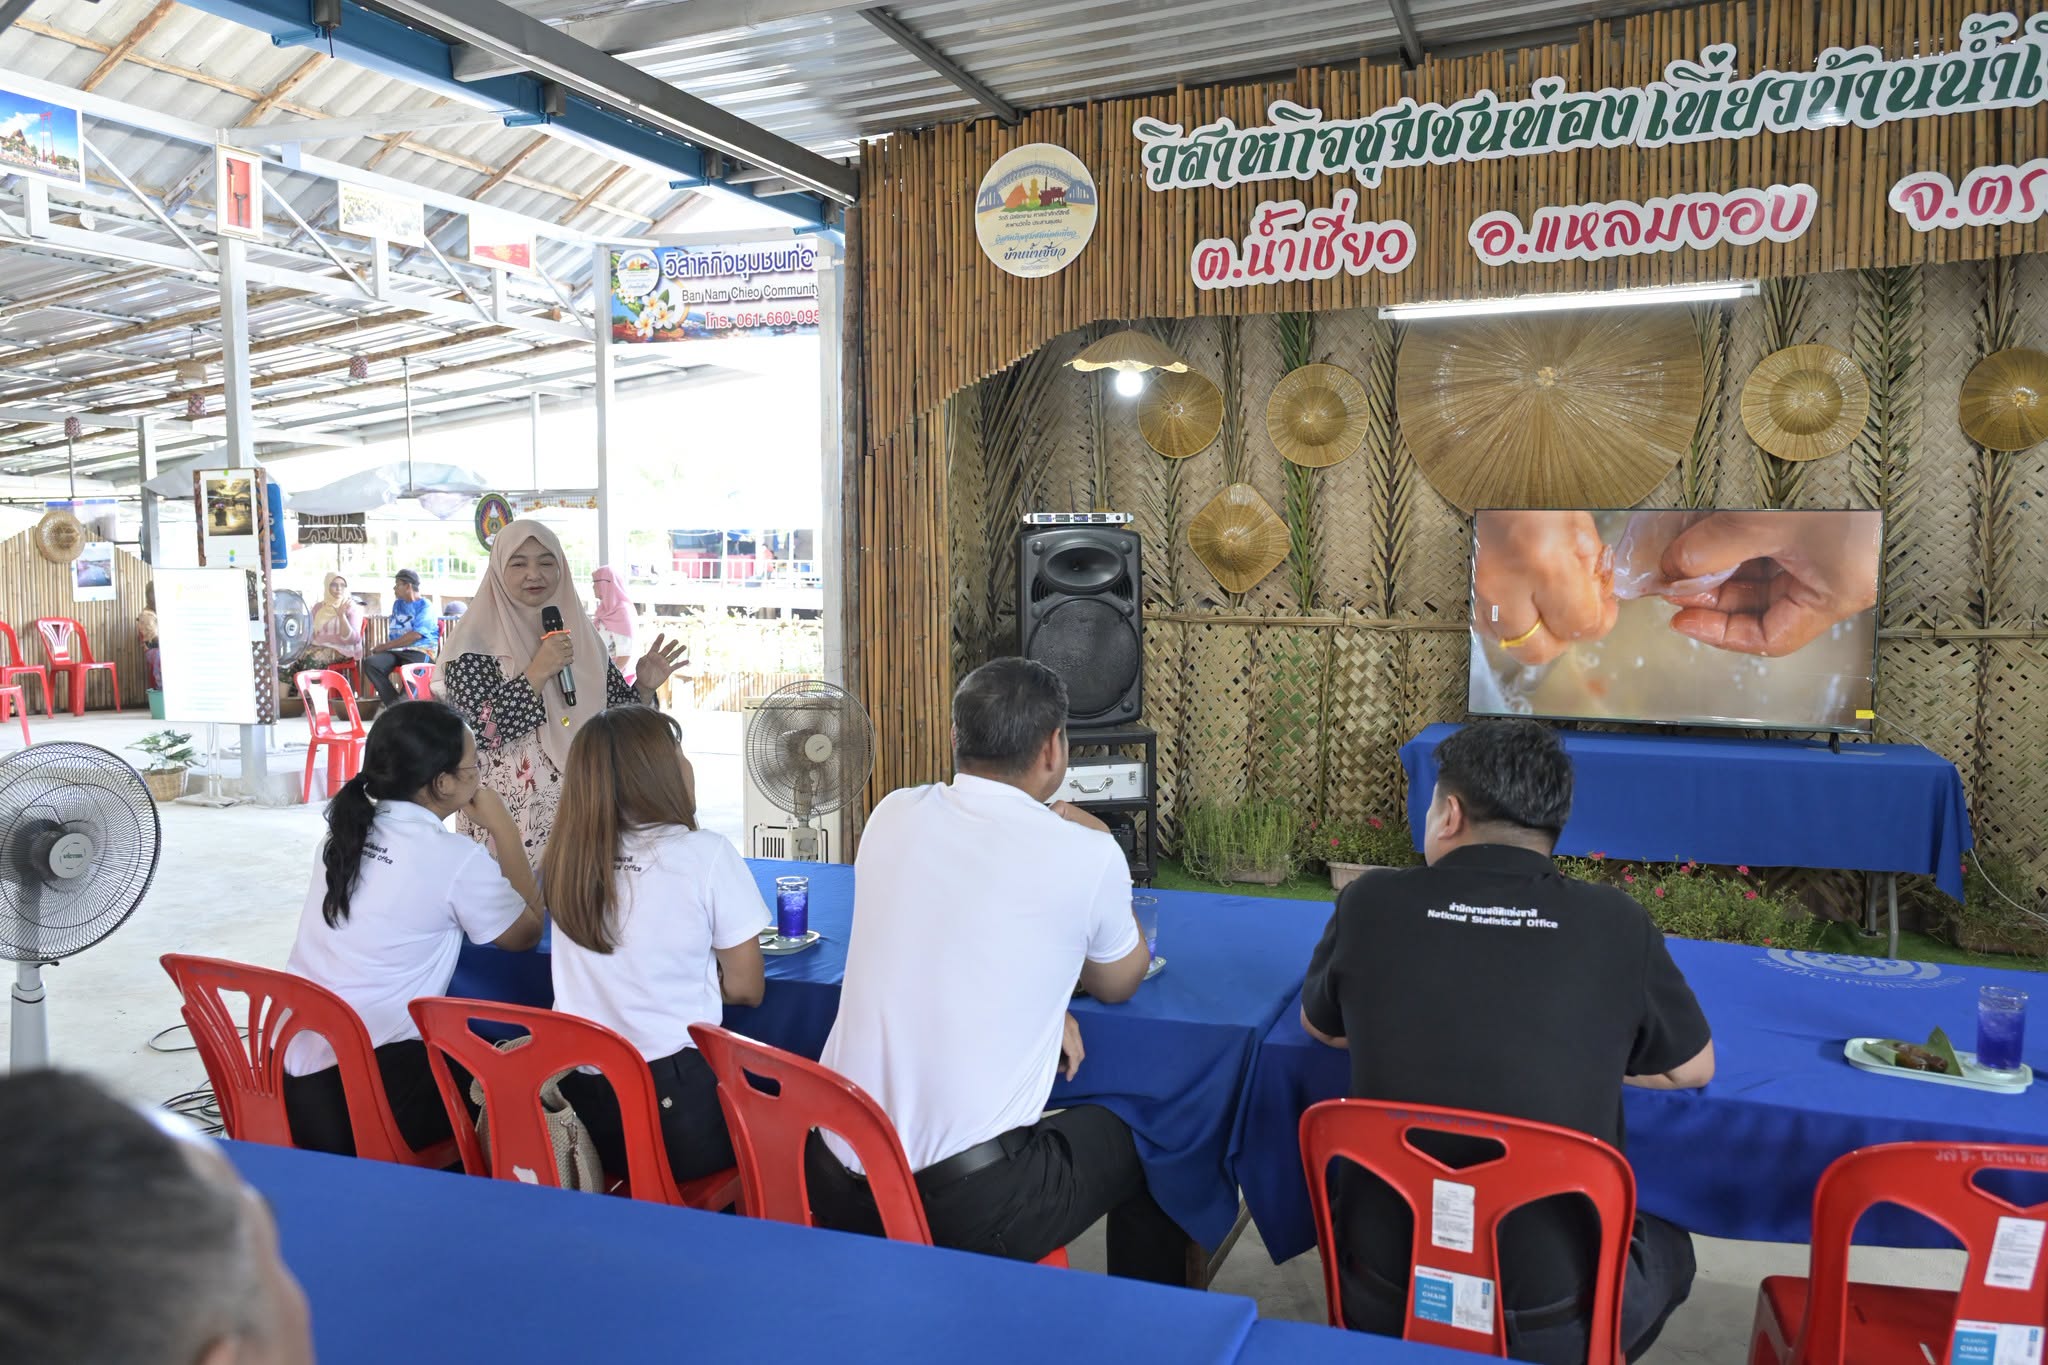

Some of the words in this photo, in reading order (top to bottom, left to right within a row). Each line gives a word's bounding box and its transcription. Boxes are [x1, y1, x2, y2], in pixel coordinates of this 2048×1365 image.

[1138, 20, 2048, 185] วิสาหกิจชุมชนท่องเที่ยวบ้านน้ำเ
[1198, 197, 1410, 281] ต.น้ำเชี่ยว
[1476, 194, 1809, 256] อ.แหลมงอบ
[665, 243, 818, 279] วิสาหกิจชุมชนท่อ
[682, 290, 701, 302] Ban
[704, 288, 727, 301] Nam
[731, 286, 760, 299] Chieo
[763, 283, 818, 299] Community
[706, 311, 731, 328] โทร.
[1427, 909, 1467, 922] National
[1471, 915, 1521, 927] Statistical
[1526, 918, 1559, 929] Office
